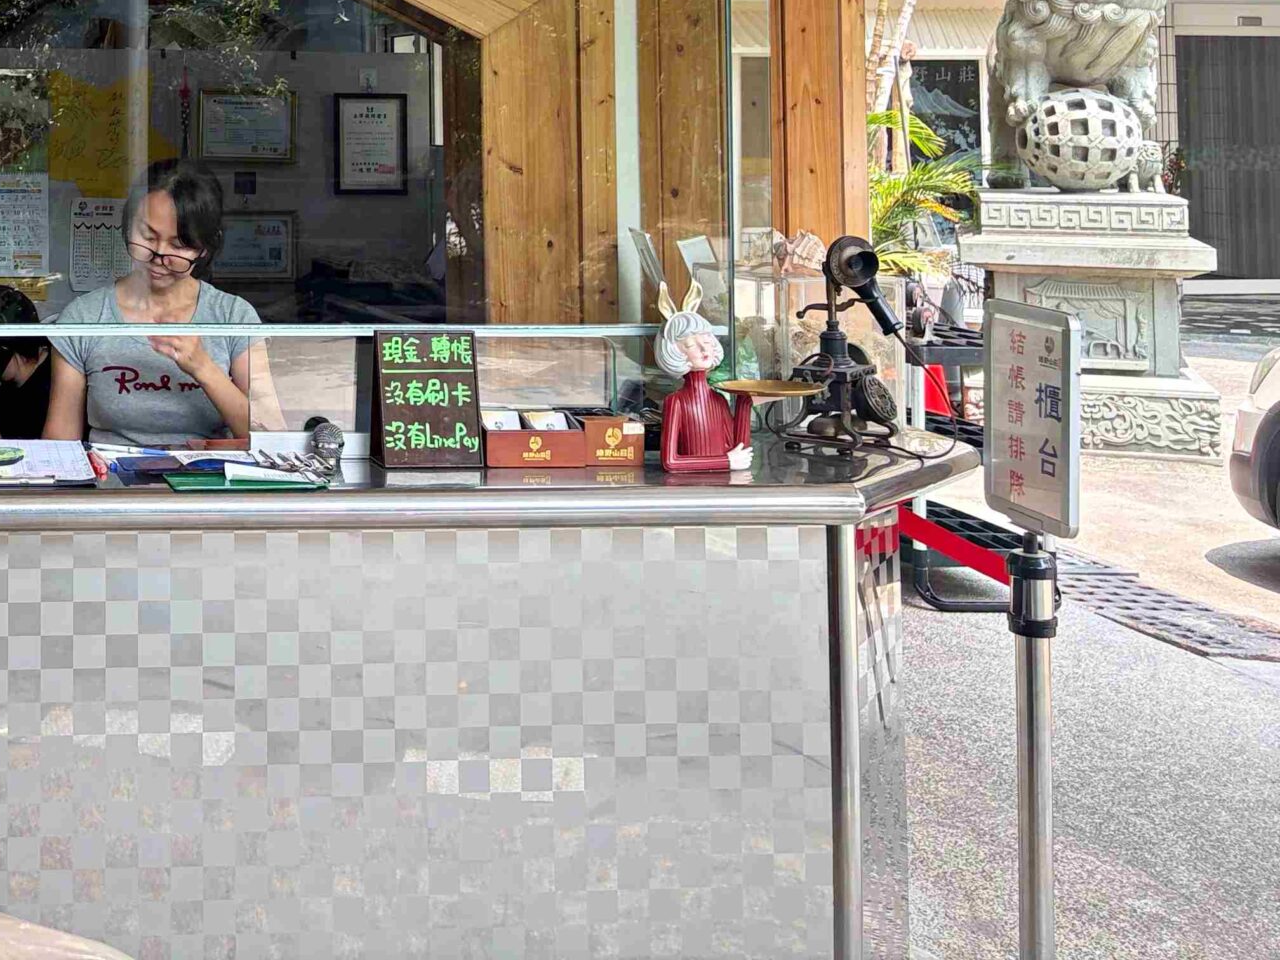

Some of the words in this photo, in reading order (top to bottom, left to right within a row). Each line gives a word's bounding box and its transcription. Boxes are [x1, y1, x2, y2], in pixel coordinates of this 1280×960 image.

[384, 378, 472, 407] 沒有刷卡
[1008, 329, 1026, 496] 結帳請排隊
[1034, 382, 1062, 477] 櫃台
